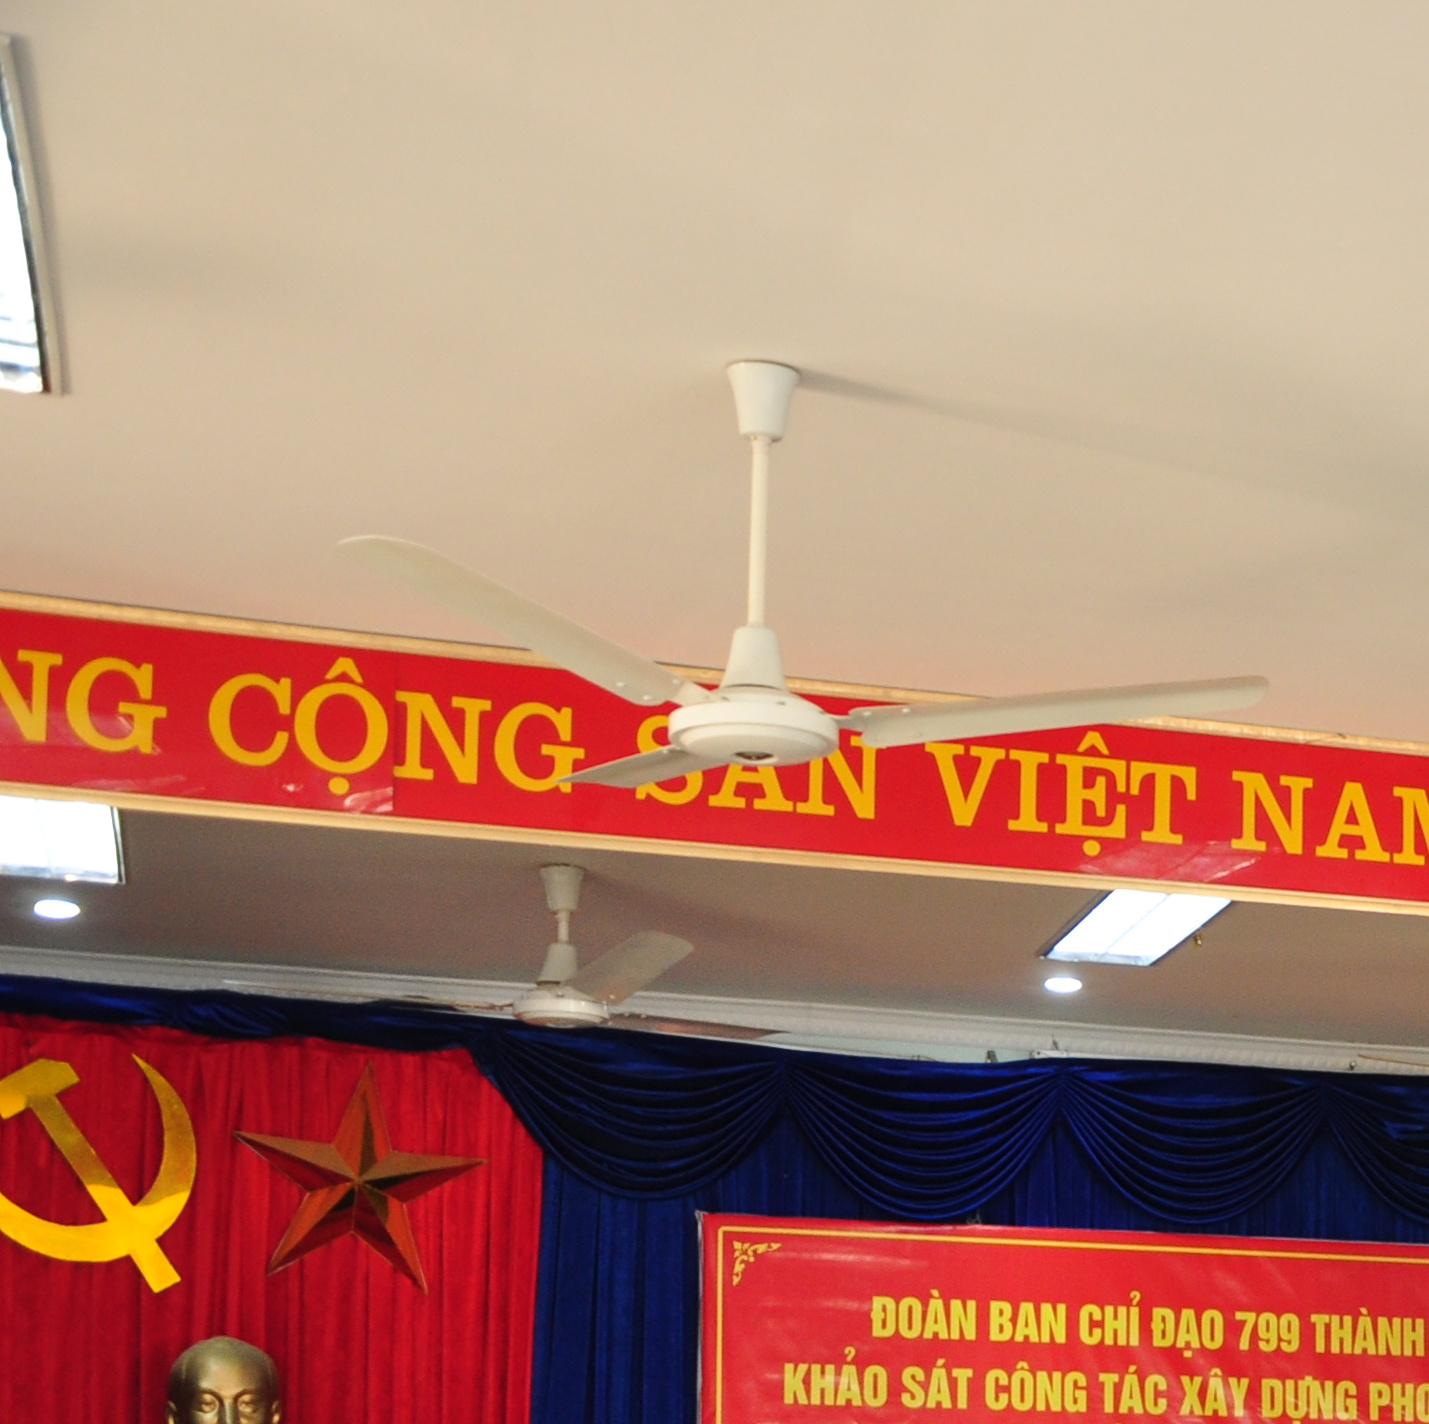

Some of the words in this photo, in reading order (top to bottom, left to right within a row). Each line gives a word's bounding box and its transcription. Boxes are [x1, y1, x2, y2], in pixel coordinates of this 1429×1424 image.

[208, 657, 586, 796] CỘNG
[924, 731, 1197, 857] VIỆT
[870, 1288, 977, 1341] ĐOÀN
[989, 1299, 1067, 1344] BAN
[1079, 1290, 1142, 1346] CHỈ
[1151, 1306, 1224, 1358] ĐẠO
[1234, 1311, 1301, 1353] 799
[1310, 1306, 1425, 1358] THÀNH
[782, 1346, 889, 1408] KHẢO
[900, 1358, 973, 1410] SÁT
[985, 1360, 1088, 1413] CÔNG
[1098, 1364, 1167, 1416] TÁC
[1178, 1367, 1250, 1418] XÂY
